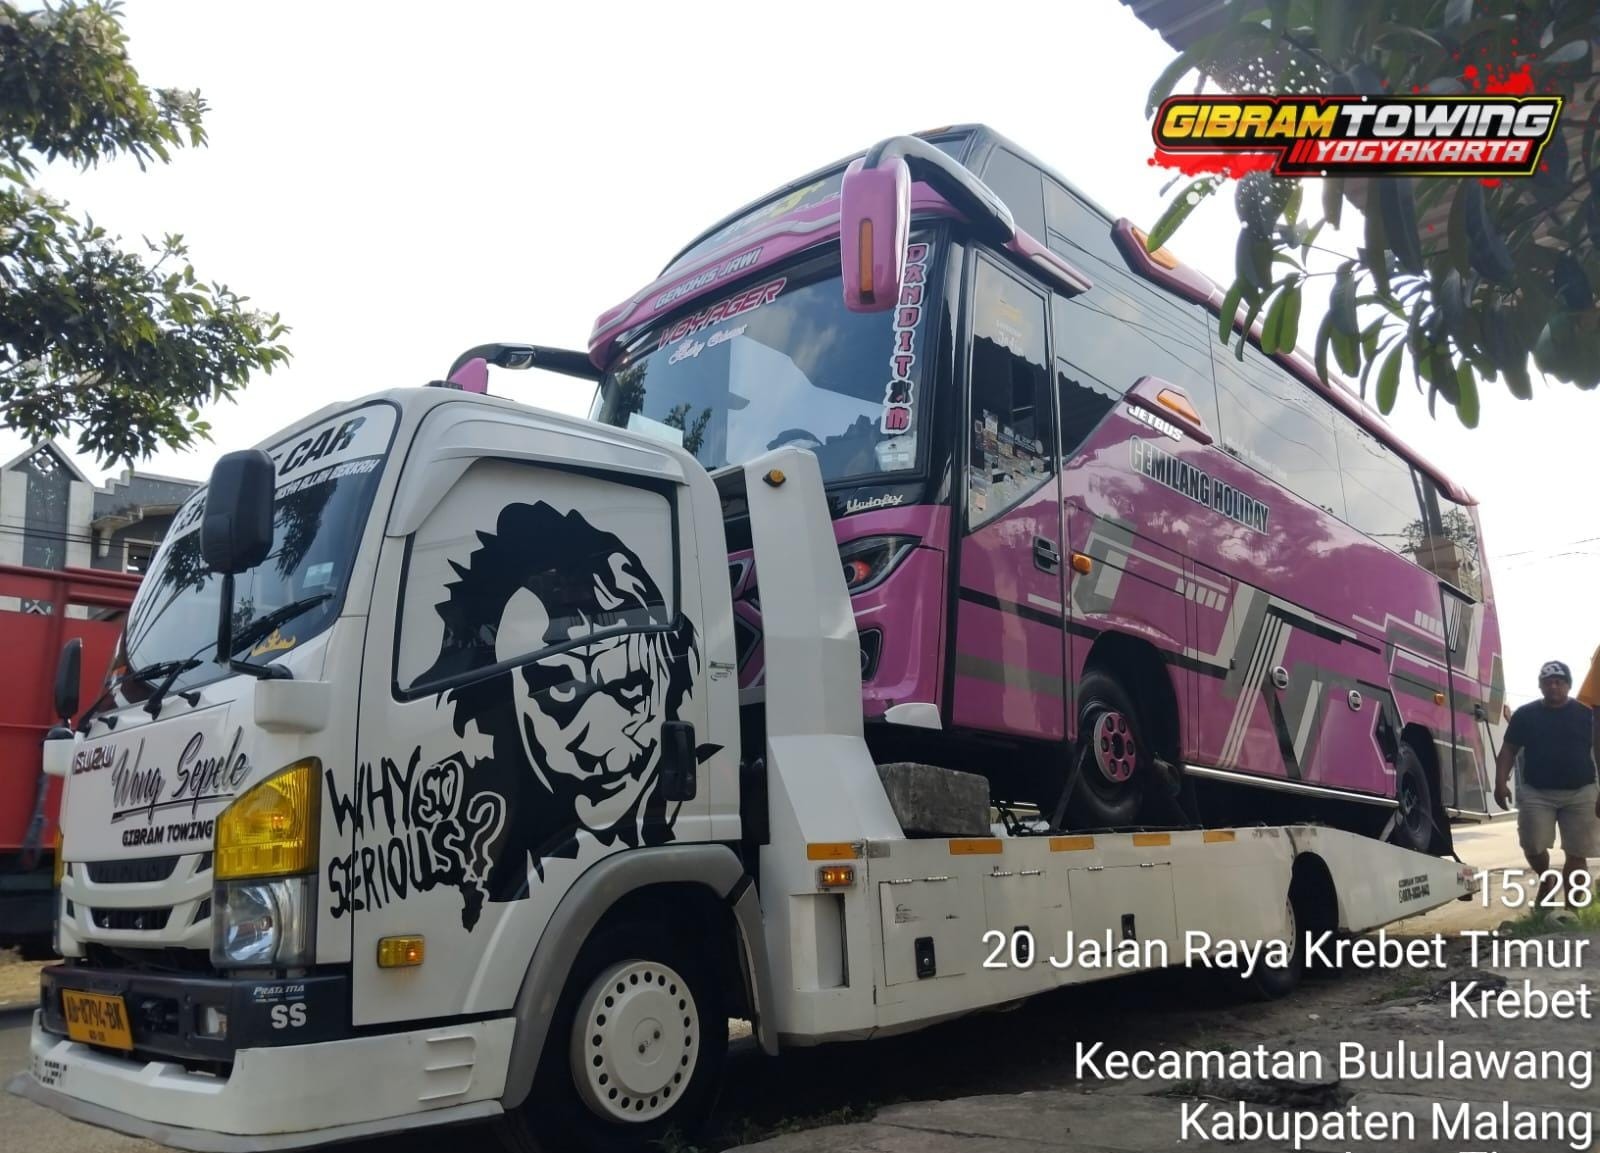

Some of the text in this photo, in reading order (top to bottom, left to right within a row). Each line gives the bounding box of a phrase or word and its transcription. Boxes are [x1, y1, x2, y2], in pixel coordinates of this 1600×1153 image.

[657, 277, 787, 352] VOYAGER
[278, 416, 367, 476] CAR
[1128, 405, 1185, 443] JETBUS
[1129, 434, 1212, 509] GEMILANG
[1212, 477, 1271, 537] HOLIDAY
[72, 744, 117, 775] ISUZU
[111, 725, 252, 824] Wong Sepele
[325, 745, 421, 840] WHY
[122, 820, 214, 847] GIBRAM TOWING
[271, 1002, 307, 1029] SS
